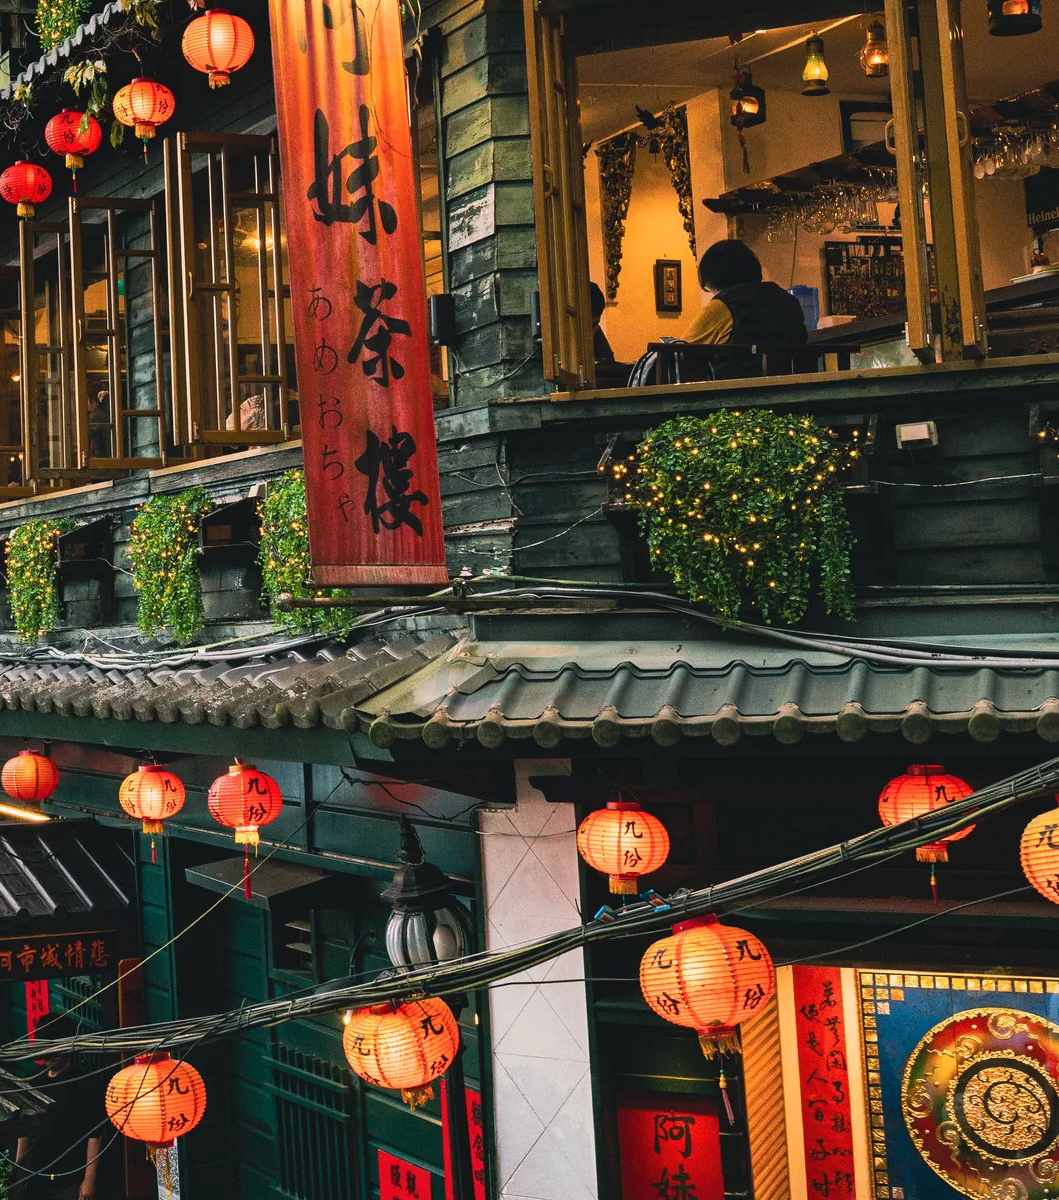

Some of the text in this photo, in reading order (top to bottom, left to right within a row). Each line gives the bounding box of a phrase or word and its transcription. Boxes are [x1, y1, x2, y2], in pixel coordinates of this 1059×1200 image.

[155, 84, 169, 115] 九份
[61, 113, 75, 145] 九份
[307, 283, 356, 522] あめおちゃ
[164, 779, 177, 812] 九份
[247, 778, 267, 822] 九份
[624, 821, 643, 867] 九份
[651, 948, 681, 1016] 九份
[736, 940, 766, 1009] 九份
[421, 1015, 450, 1077] 九份
[167, 1077, 190, 1132] 九份
[651, 1114, 699, 1200] 阿妹
